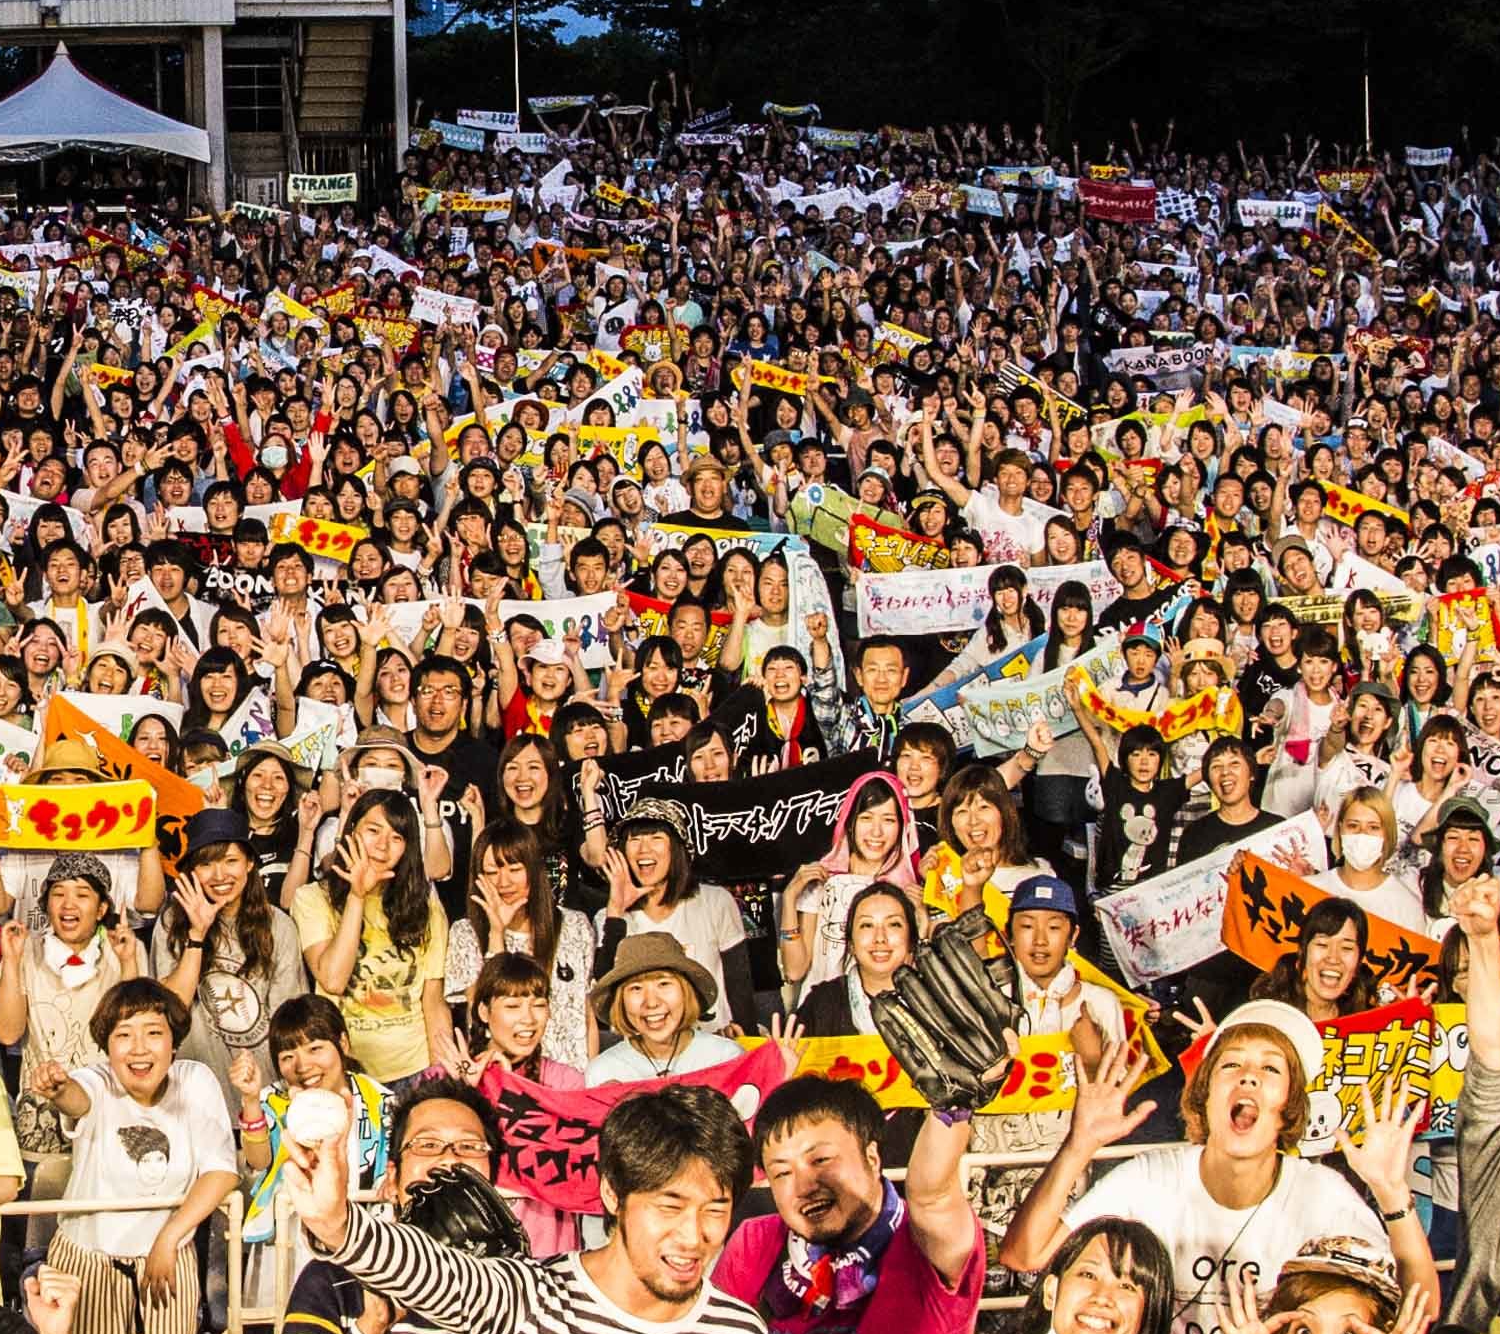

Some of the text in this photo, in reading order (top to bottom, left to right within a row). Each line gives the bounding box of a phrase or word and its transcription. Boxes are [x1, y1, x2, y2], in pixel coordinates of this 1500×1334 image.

[292, 177, 353, 191] STRANGE
[28, 797, 153, 841] キュウソ
